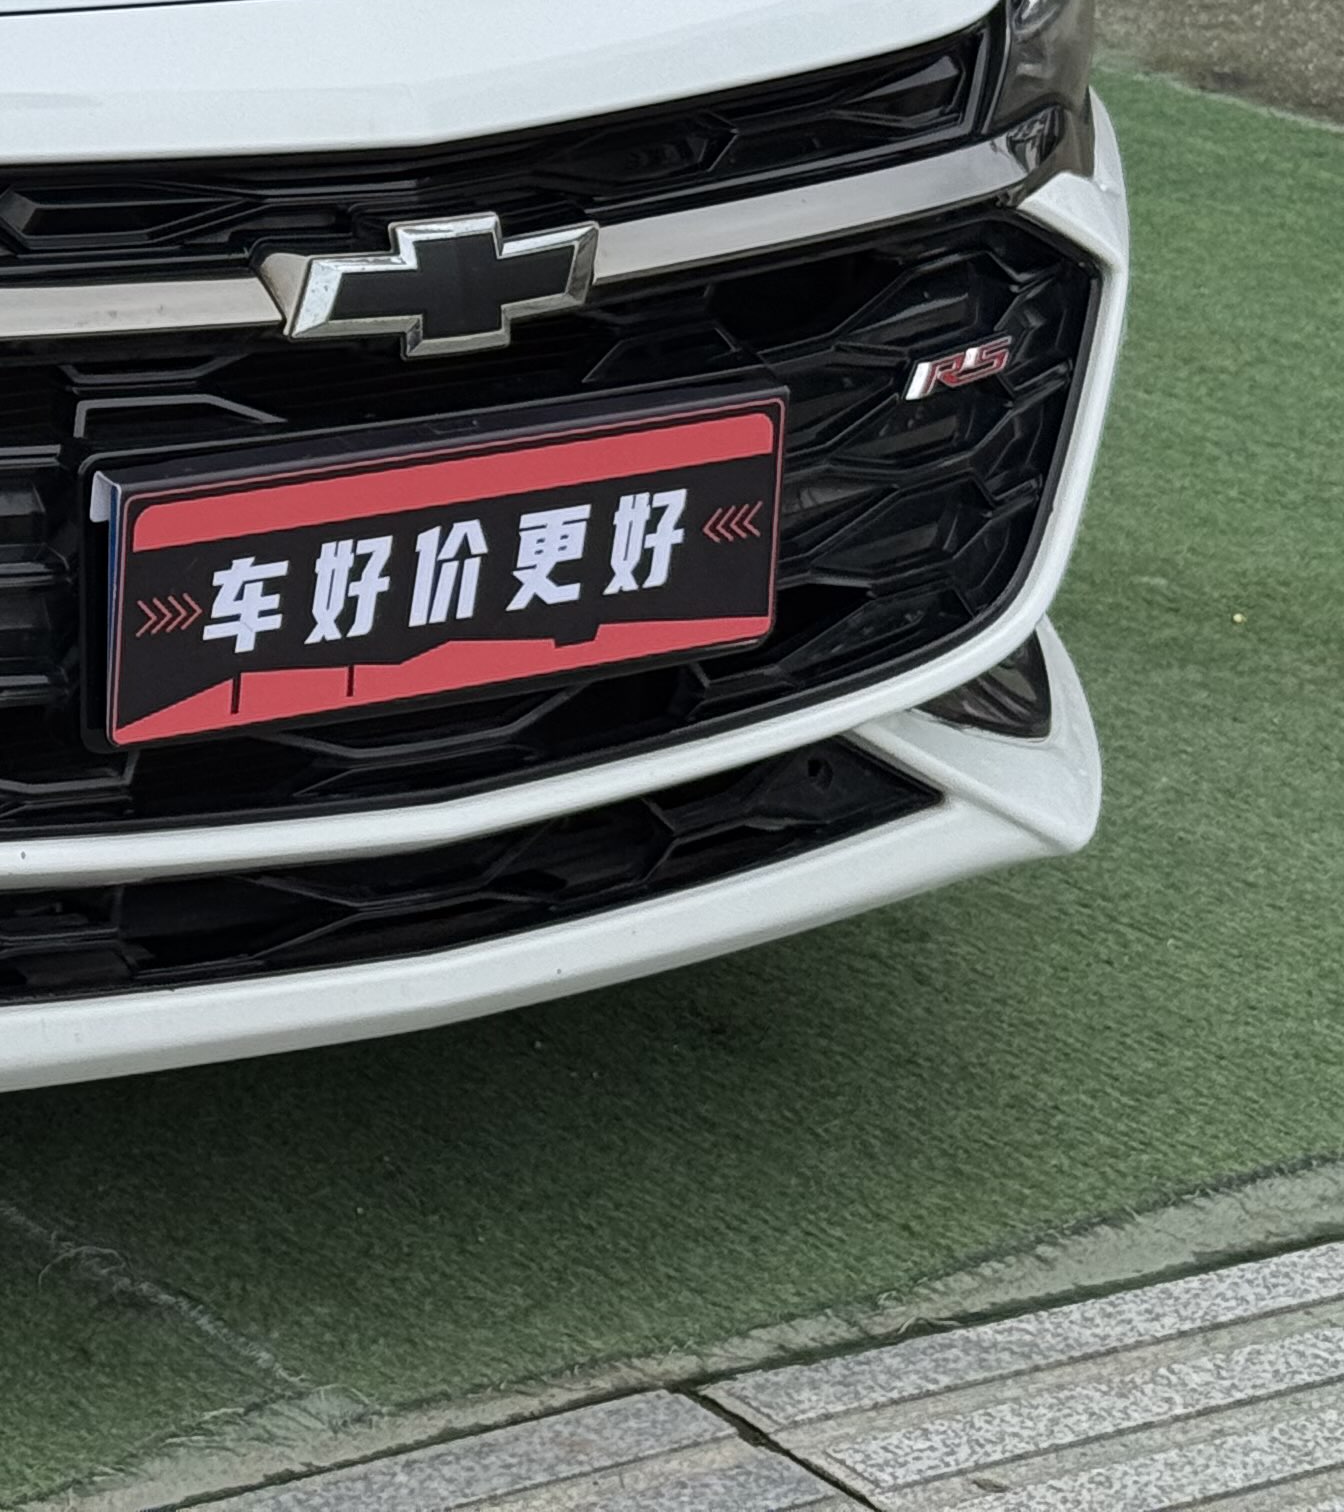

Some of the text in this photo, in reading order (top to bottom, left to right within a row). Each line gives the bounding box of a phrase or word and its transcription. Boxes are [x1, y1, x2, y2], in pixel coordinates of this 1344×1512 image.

[905, 335, 1013, 401] RS
[200, 485, 686, 654] 车好价更好
